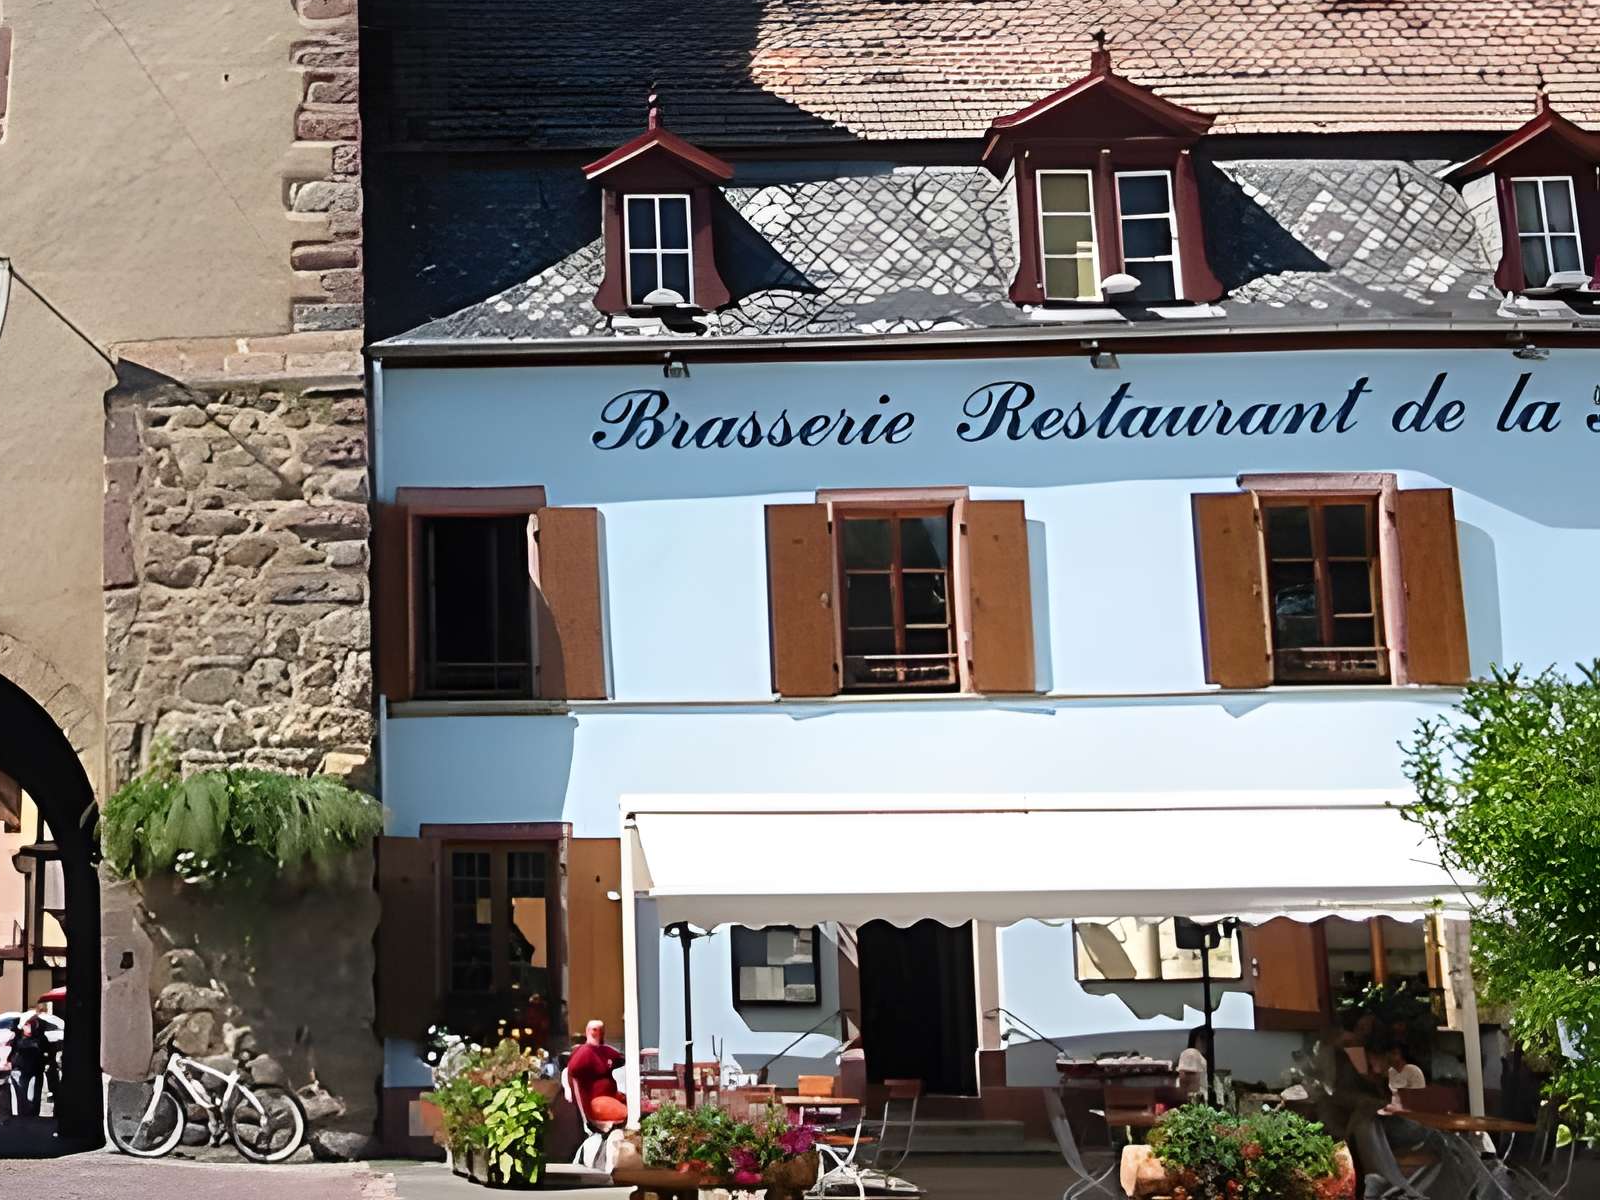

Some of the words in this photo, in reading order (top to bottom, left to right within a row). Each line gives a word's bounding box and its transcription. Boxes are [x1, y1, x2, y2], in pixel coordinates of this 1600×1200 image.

[592, 389, 915, 450] Brasserie
[956, 376, 1372, 442] Restaurant
[1391, 372, 1465, 433] de
[1496, 372, 1561, 433] la
